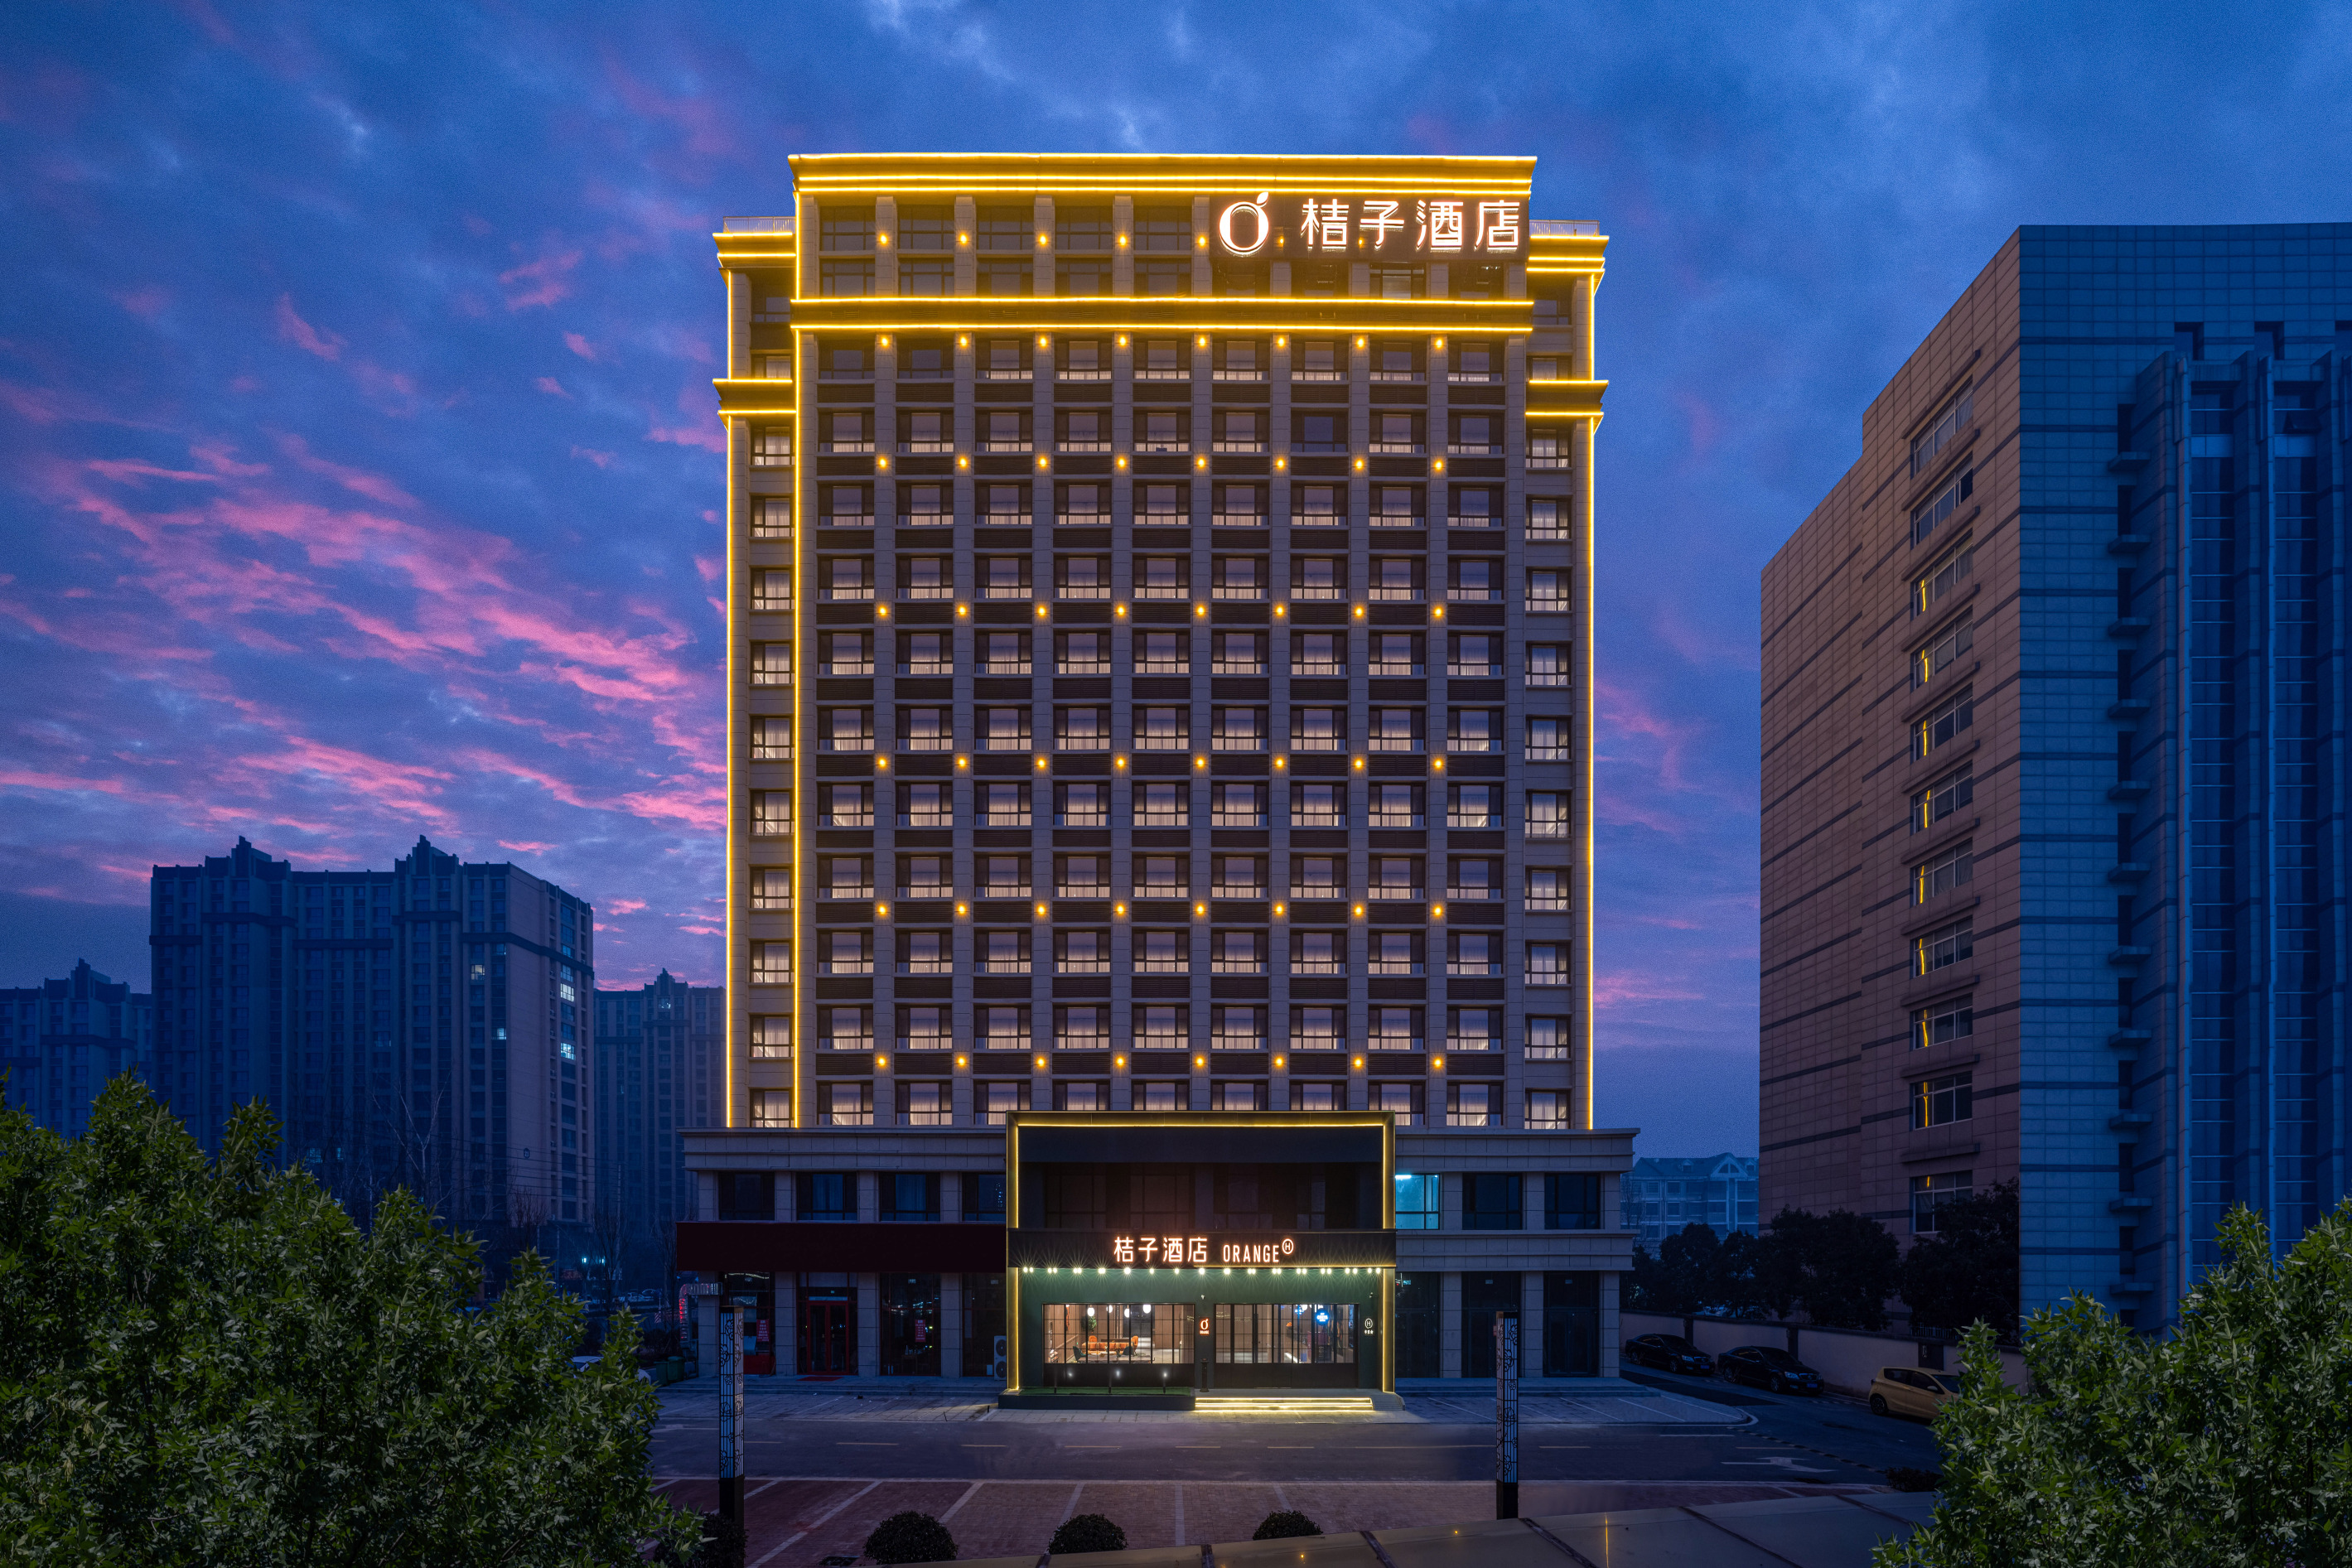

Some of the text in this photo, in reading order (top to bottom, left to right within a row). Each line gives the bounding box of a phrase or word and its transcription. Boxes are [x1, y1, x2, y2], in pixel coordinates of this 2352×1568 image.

[1300, 198, 1521, 251] 桔子酒店
[1113, 1236, 1208, 1262] 桔子酒店
[1222, 1244, 1280, 1263] ORANGE
